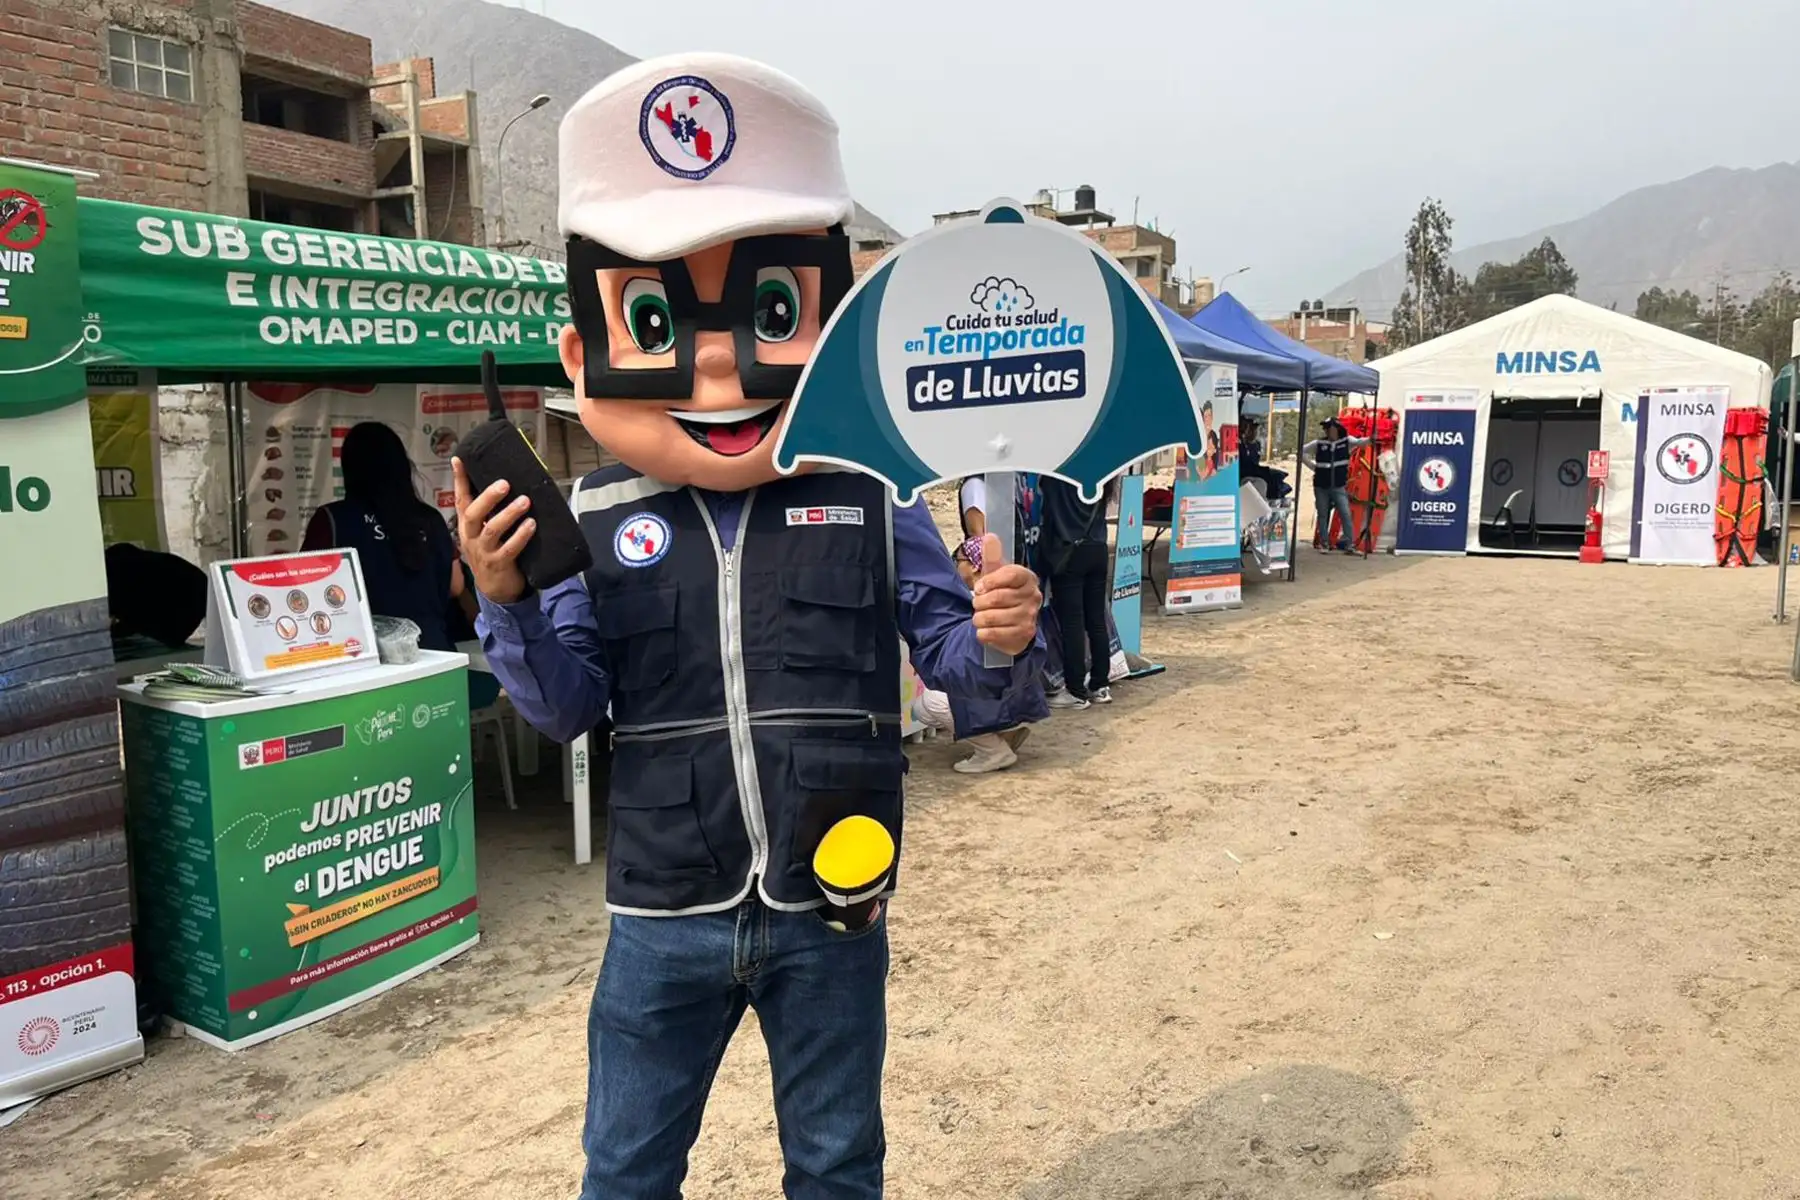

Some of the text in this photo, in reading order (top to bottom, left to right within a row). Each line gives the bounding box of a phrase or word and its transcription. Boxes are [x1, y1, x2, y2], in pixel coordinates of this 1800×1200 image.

[136, 216, 567, 284] SUB GERENCIA DE B
[226, 271, 259, 307] E
[269, 274, 548, 316] INTEGRACIÓN
[259, 315, 418, 345] OMAPED
[447, 320, 521, 345] CIAM
[546, 323, 573, 345] D
[946, 308, 1058, 331] Cuida tu salud
[904, 318, 1085, 360] en Temporada
[1496, 350, 1602, 374] MINSA
[914, 362, 1079, 404] de Lluvias
[1660, 403, 1715, 416] MINSA
[1412, 431, 1464, 446] MINSA
[1411, 500, 1457, 514] DIGERD
[1654, 502, 1711, 515] DIGERD
[1118, 545, 1140, 557] MINSA
[301, 777, 412, 832] JUNTOS
[265, 802, 441, 873] podemos PREVENIR
[294, 835, 424, 898] el DENGUE
[363, 898, 375, 909] NO
[375, 892, 392, 905] HAY
[40, 964, 93, 986] opción
[96, 958, 106, 969] 1.
[290, 973, 308, 985] Para
[309, 967, 325, 978] más
[326, 948, 369, 971] información
[369, 942, 388, 954] llama
[388, 933, 407, 947] gratis
[62, 1005, 106, 1023] BICENTENARIO
[73, 1021, 97, 1036] 2024
